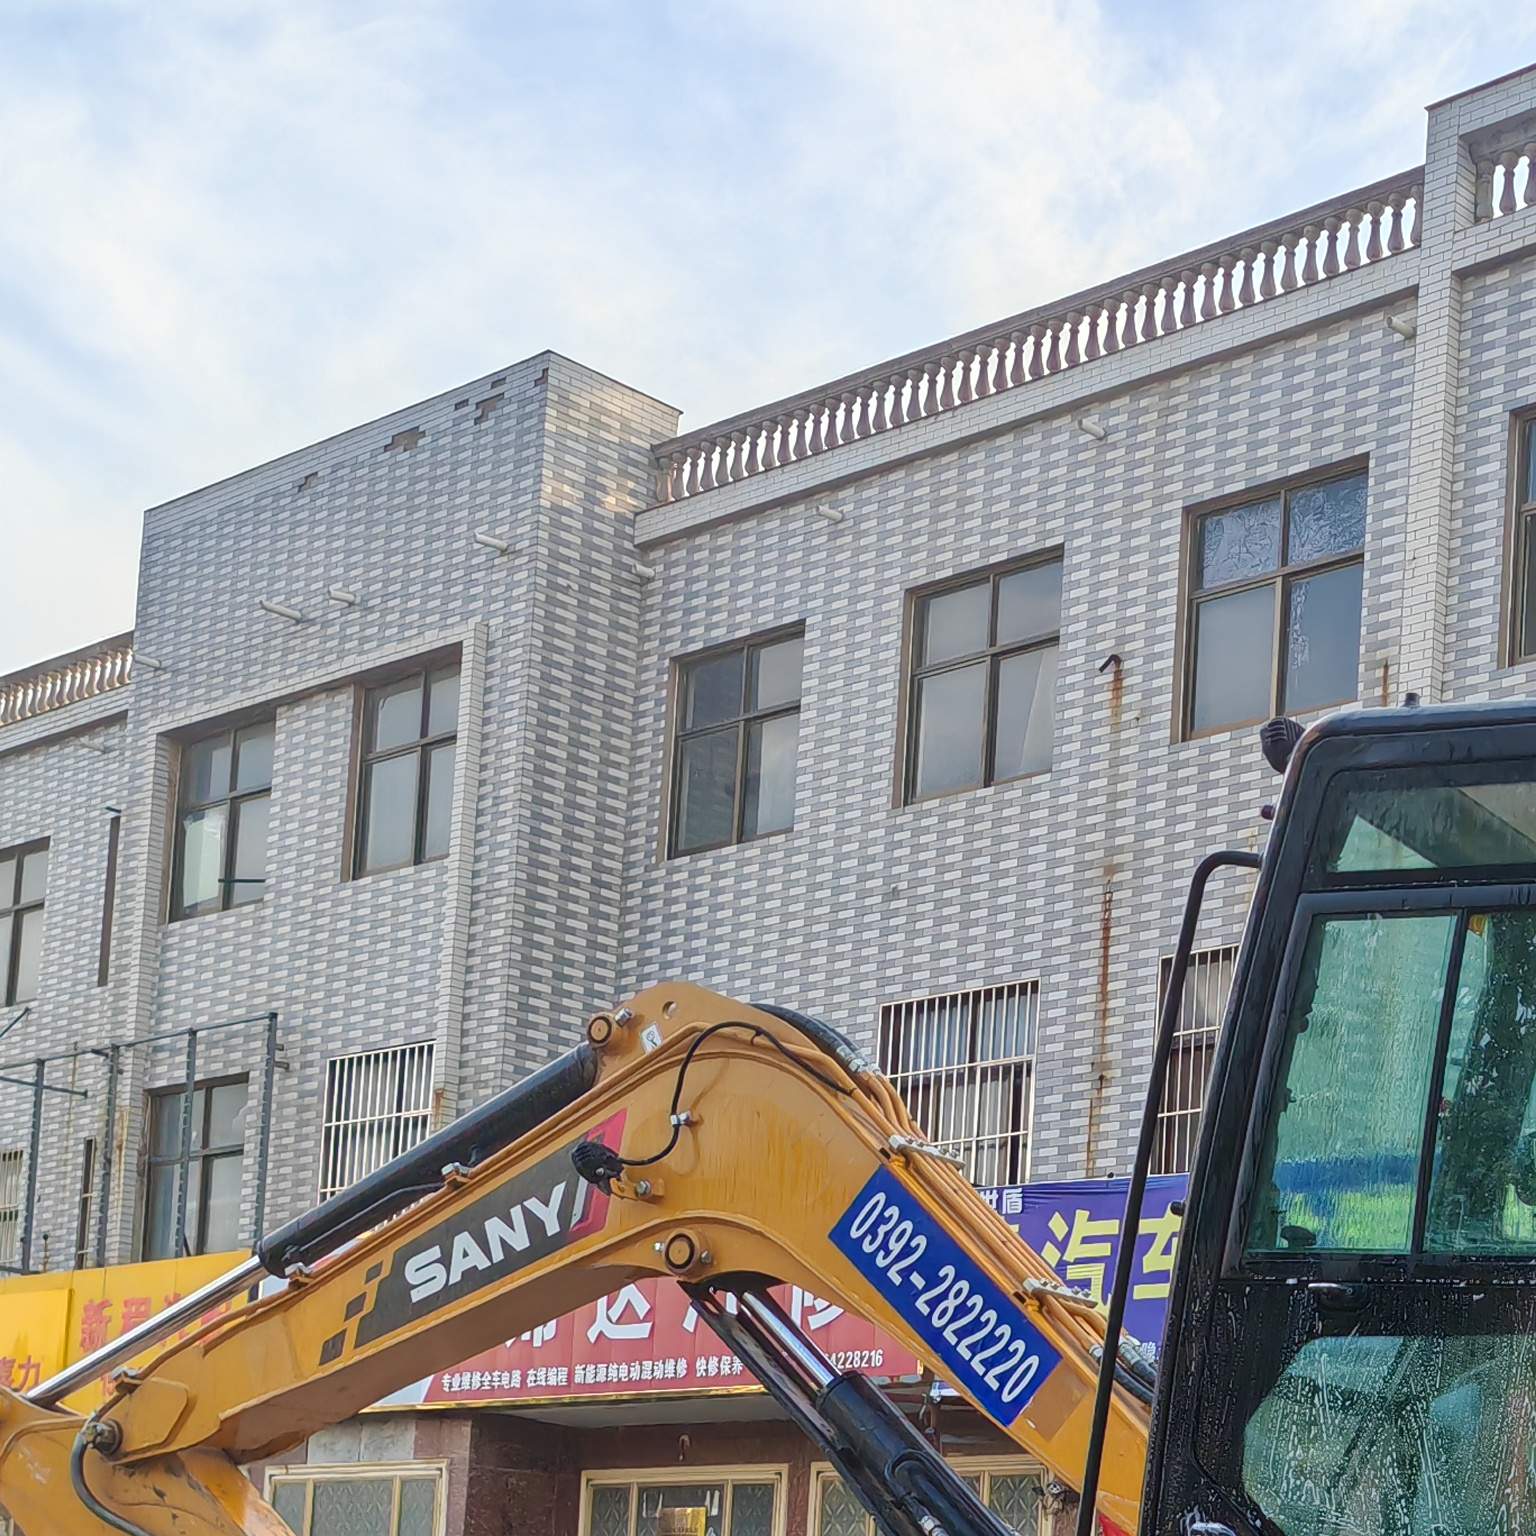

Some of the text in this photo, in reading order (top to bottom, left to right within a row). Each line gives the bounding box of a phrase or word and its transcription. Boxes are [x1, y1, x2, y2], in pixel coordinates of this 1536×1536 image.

[404, 1180, 567, 1304] SANY
[848, 1190, 1041, 1405] 0392-2822220
[1003, 1200, 1184, 1318] 汽车
[441, 1368, 522, 1393] 专业维修全车电路
[526, 1365, 569, 1388] 在线编程
[695, 1354, 744, 1377] 快修保养
[825, 1349, 884, 1369] 4228216
